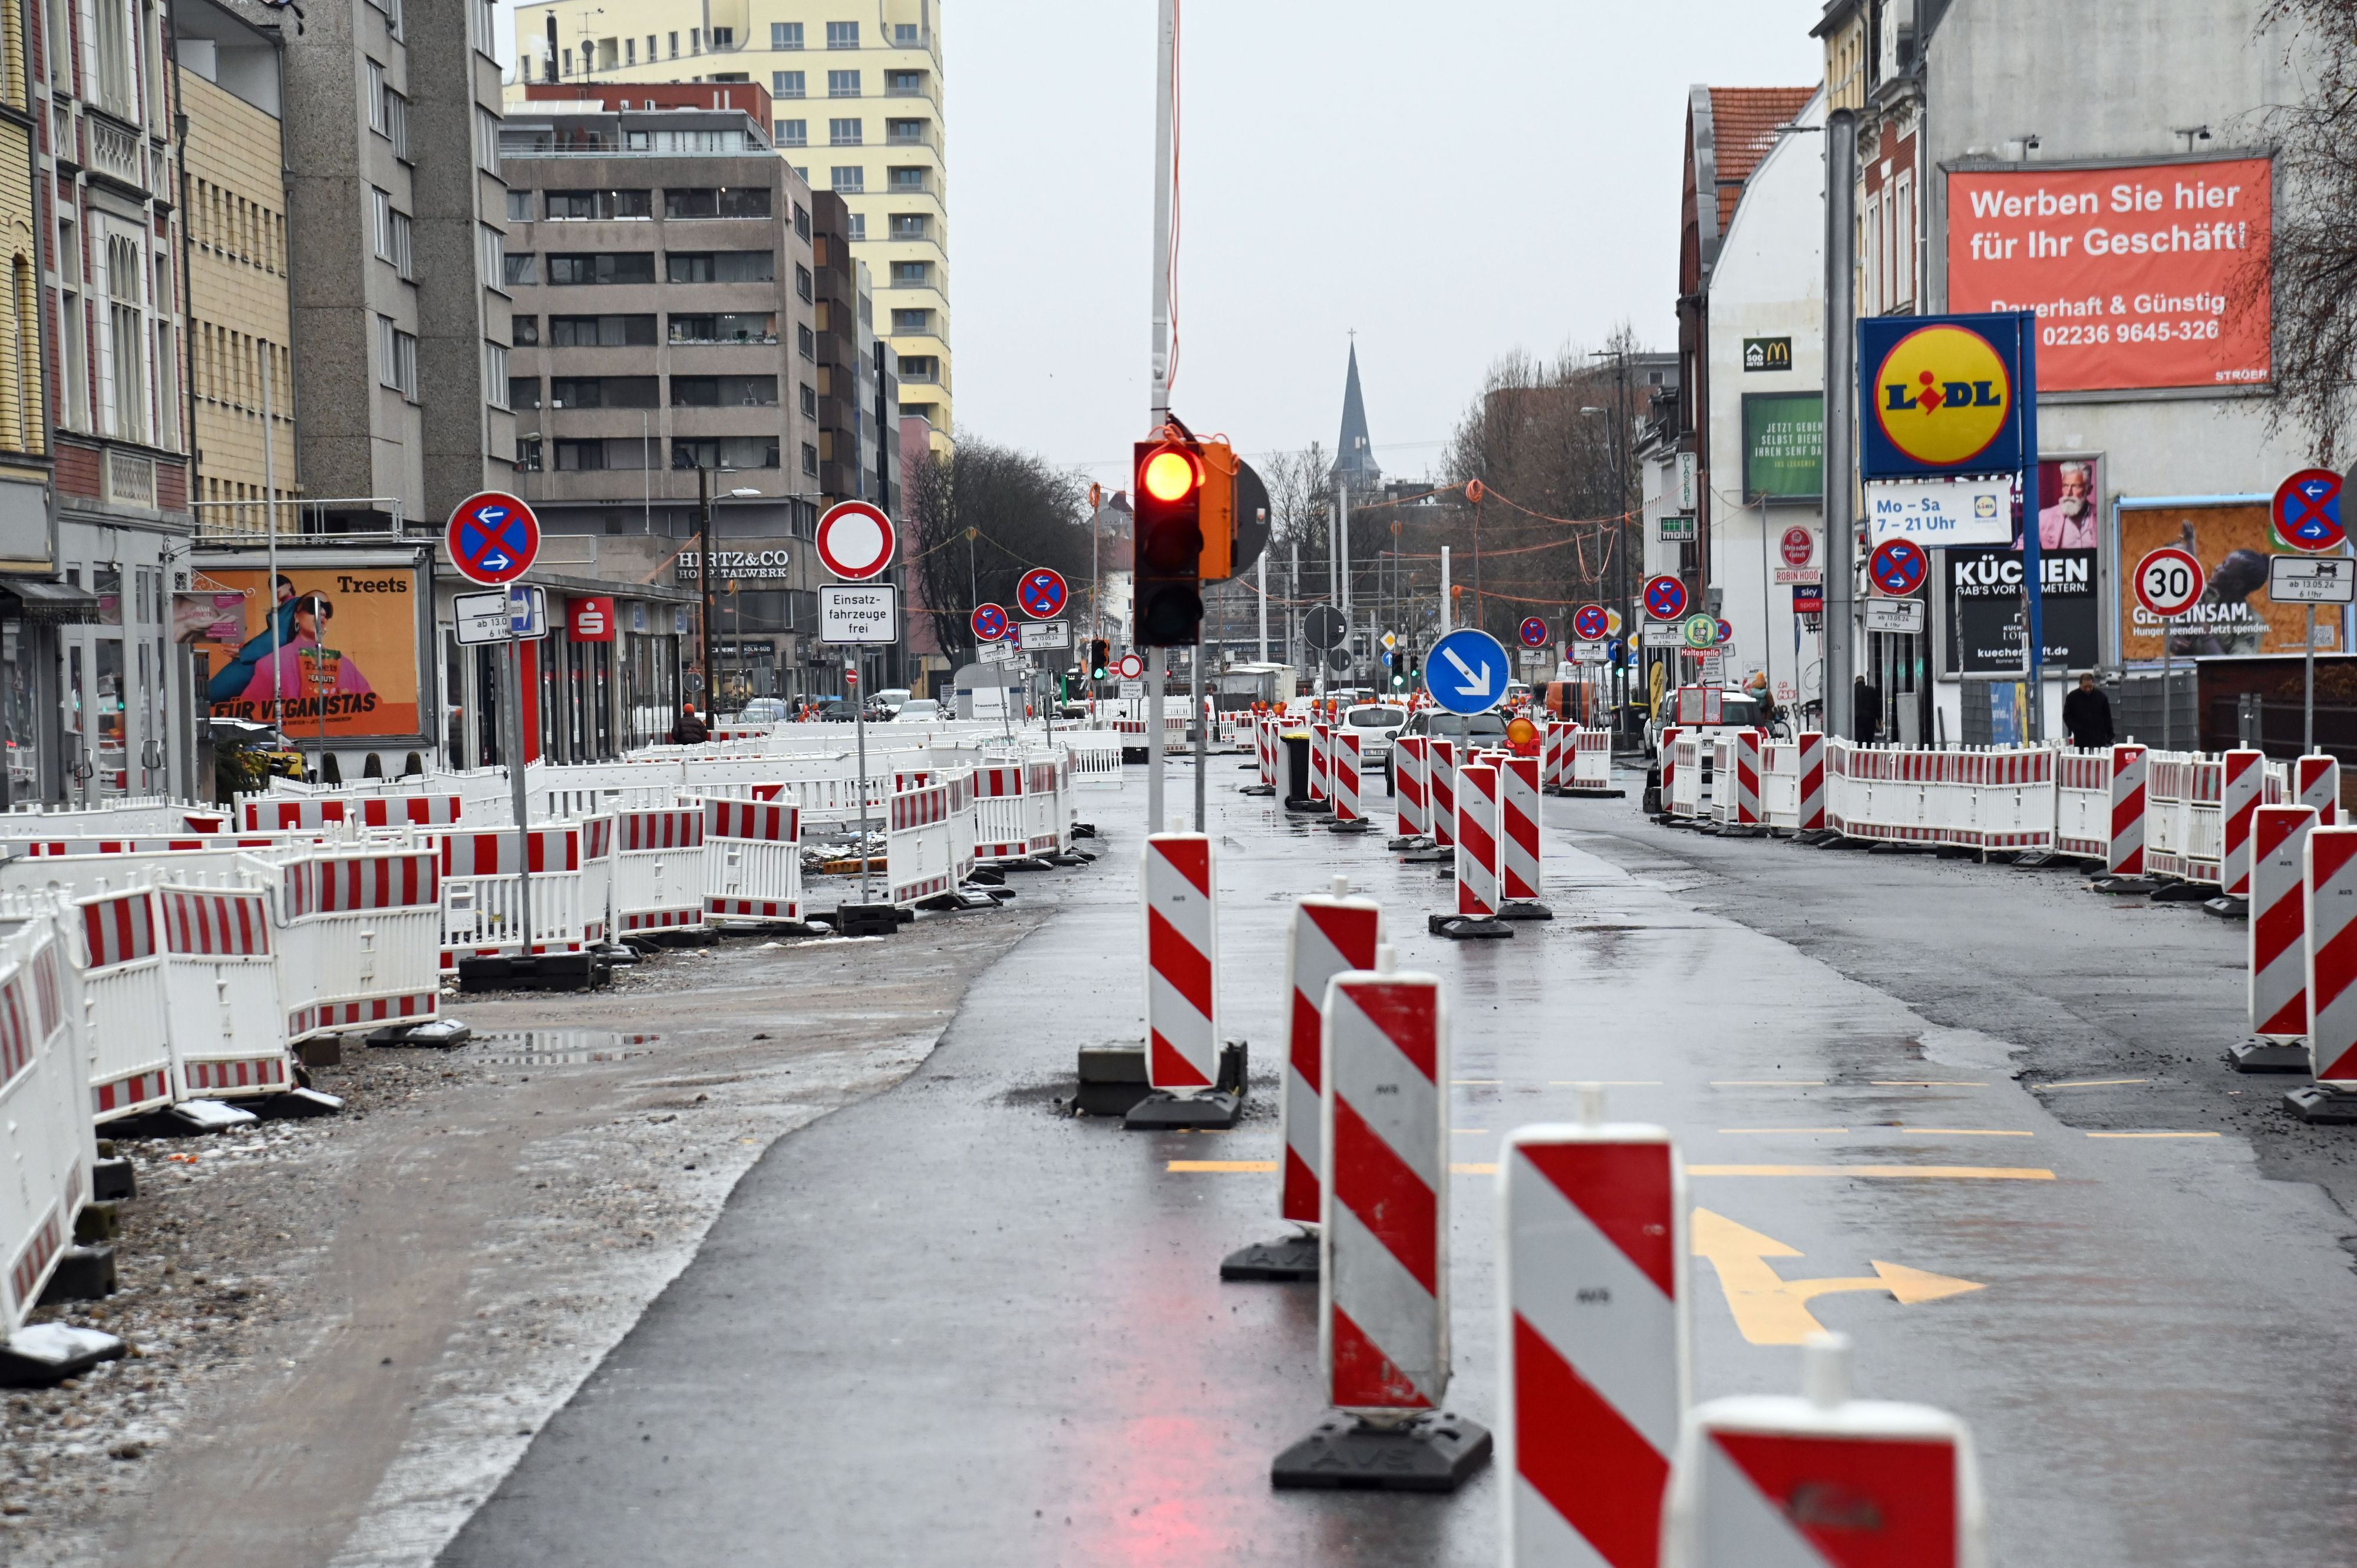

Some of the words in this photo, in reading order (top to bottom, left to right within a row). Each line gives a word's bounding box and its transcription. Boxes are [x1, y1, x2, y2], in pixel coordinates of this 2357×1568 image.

[1970, 190, 2099, 219] Werben
[2110, 185, 2163, 212] Sie
[2175, 181, 2240, 210] hier
[1970, 233, 2017, 260] für
[2029, 231, 2072, 258] Ihr
[2084, 222, 2246, 255] Geschäft!
[2110, 297, 2126, 315] &
[2134, 293, 2226, 316] Günstig
[2043, 325, 2110, 345] 02236
[2117, 321, 2219, 343] 9645-326
[2215, 369, 2268, 381] STRÖER
[1767, 423, 1791, 433] JETZT
[1797, 422, 1823, 432] GEBEN
[1761, 434, 1792, 445] SELBST
[1755, 447, 1781, 457] IHREN
[1785, 446, 1807, 457] SENF
[1877, 500, 1902, 513] Mo
[1922, 498, 1940, 511] Sa
[1877, 519, 1886, 532] 7
[1904, 517, 1921, 531] 21
[1926, 517, 1956, 530] Uhr
[1777, 572, 1798, 580] ROBIN
[1800, 570, 1818, 580] HOOD
[337, 576, 407, 593] Treets
[1992, 585, 2015, 595] VOR
[2041, 583, 2088, 593] METERN.
[2148, 568, 2188, 598] 30
[1801, 588, 1818, 597] sky
[834, 595, 881, 605] Einsatz-
[829, 609, 886, 621] fahrzeuge
[491, 618, 507, 626] 13.0
[849, 623, 868, 633] frei
[2133, 626, 2164, 637] Hunger
[2209, 625, 2232, 635] Jetzt
[2233, 623, 2272, 635] spenden.
[1681, 649, 1719, 657] Haltestelle
[215, 696, 255, 720] FÜR
